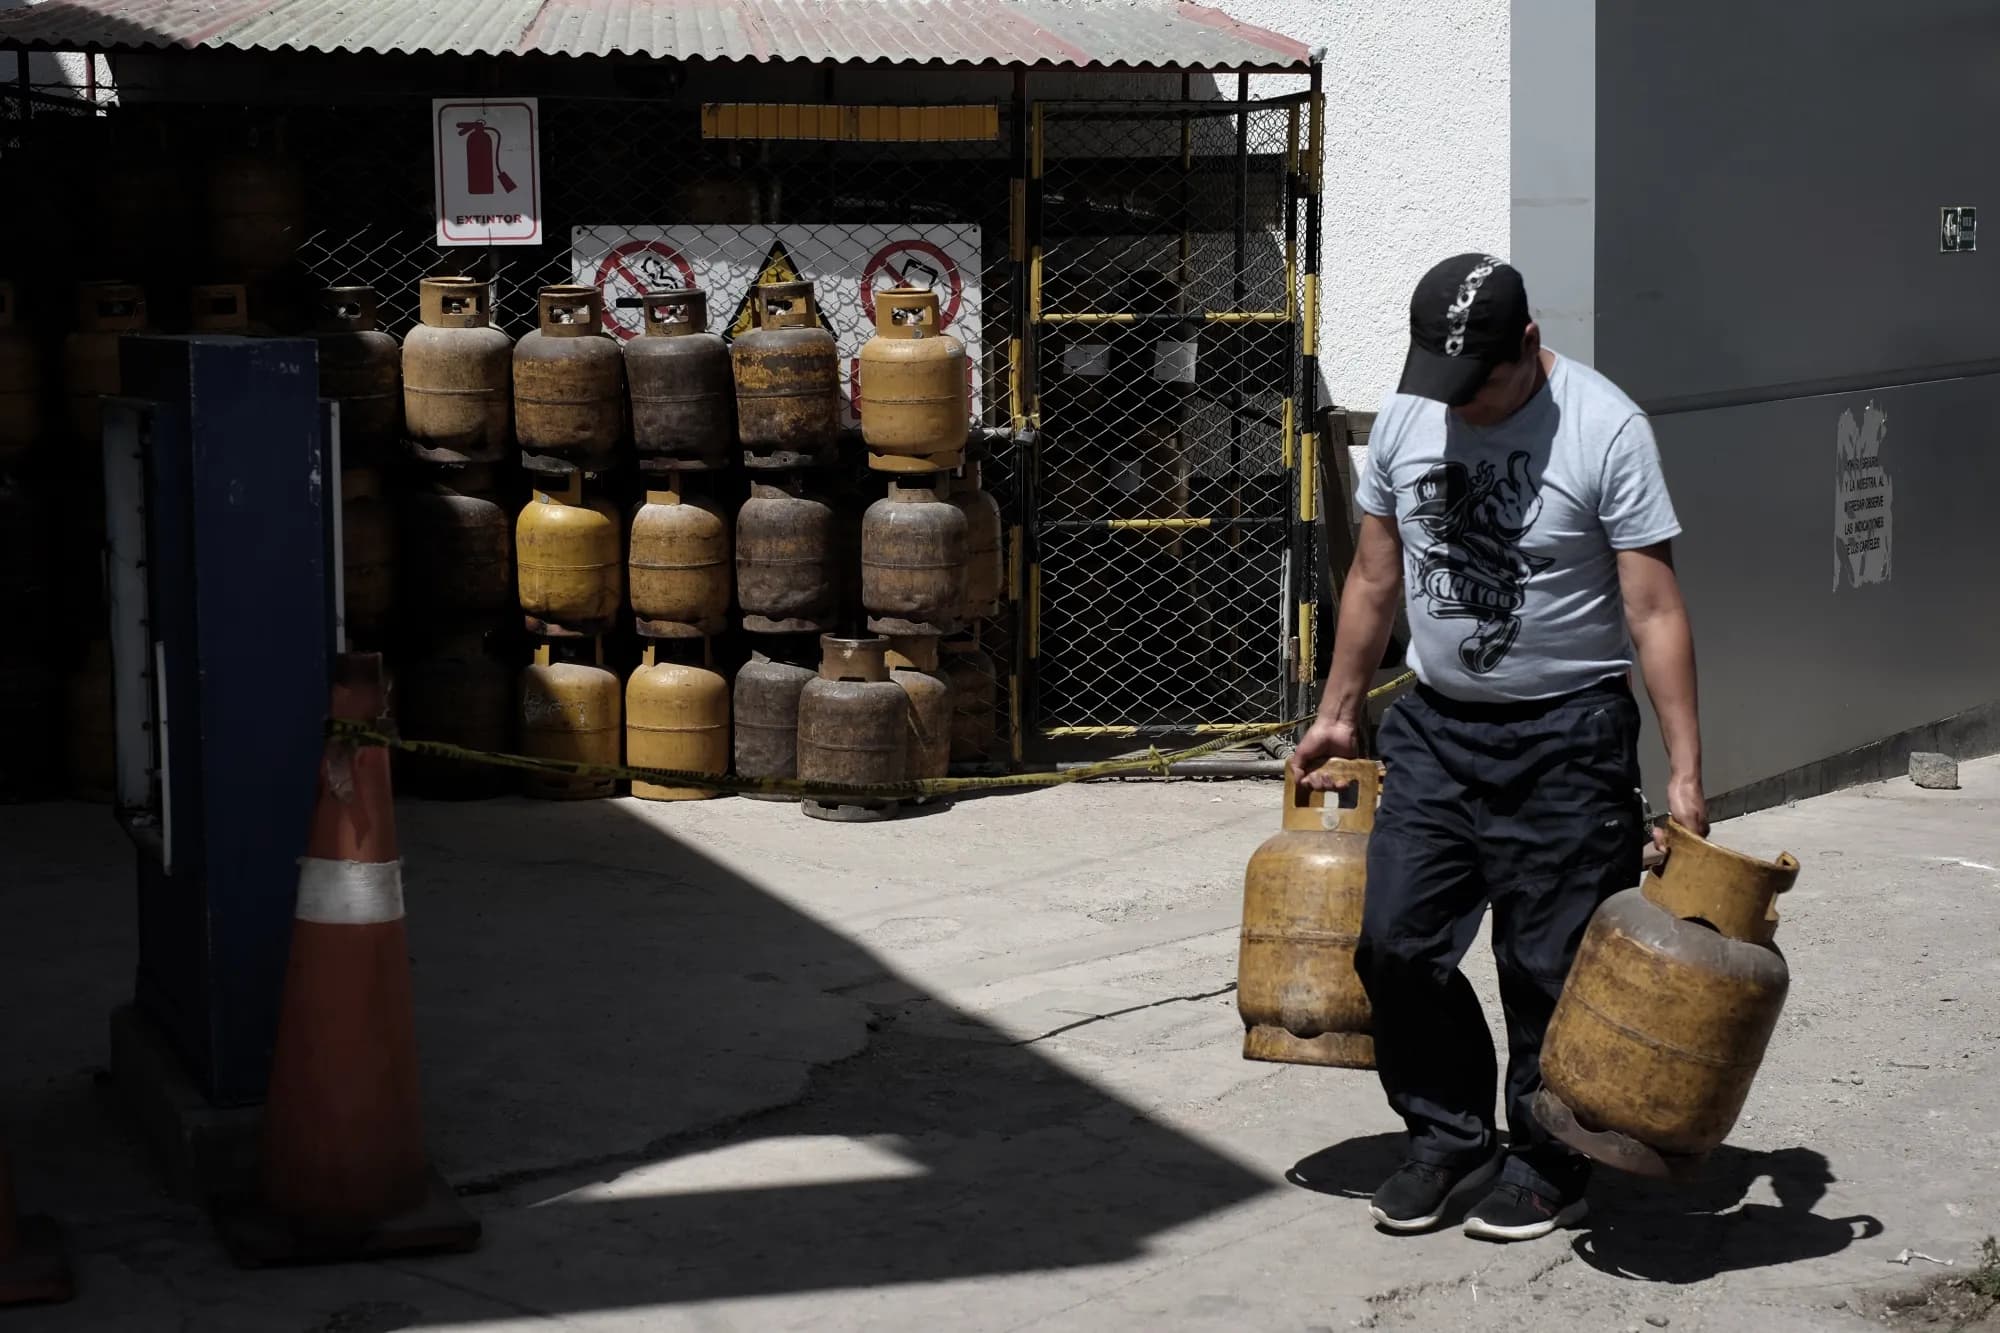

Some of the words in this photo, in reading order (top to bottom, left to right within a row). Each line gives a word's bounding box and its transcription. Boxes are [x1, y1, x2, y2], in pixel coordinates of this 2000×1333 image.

[456, 214, 522, 225] EXTINTOR
[1431, 571, 1473, 603] FUCK
[1476, 585, 1511, 608] YOU
